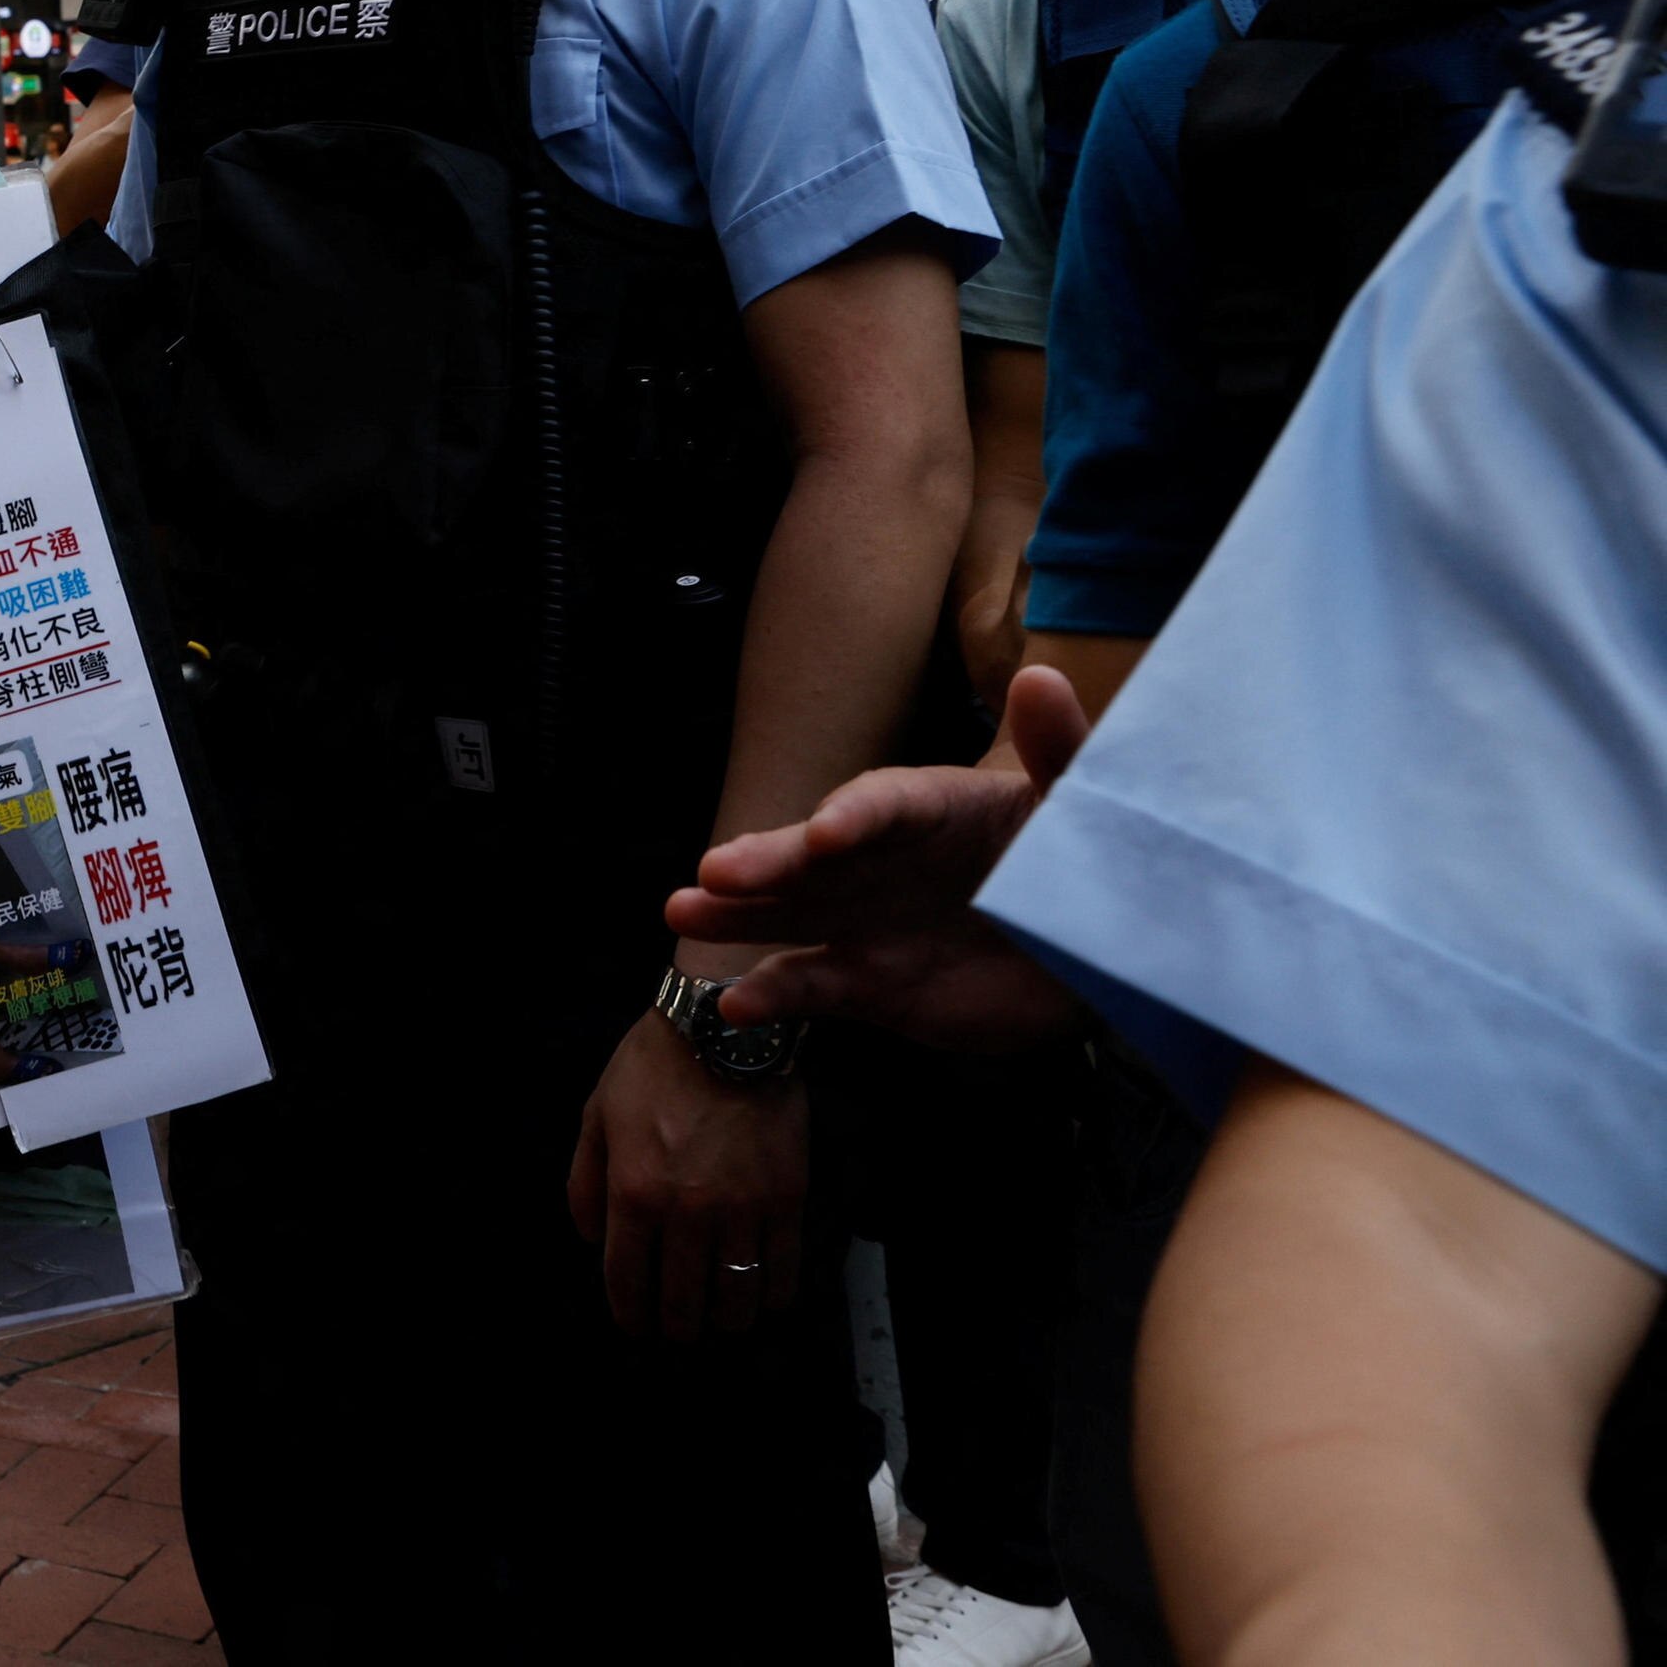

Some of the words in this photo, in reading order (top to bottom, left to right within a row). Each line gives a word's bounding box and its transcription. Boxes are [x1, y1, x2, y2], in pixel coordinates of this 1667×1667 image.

[205, 11, 238, 56] 警
[237, 2, 352, 47] POLICE
[55, 746, 148, 836] 腰痛
[82, 836, 174, 927] 腳痺
[106, 926, 196, 1015] 陀背
